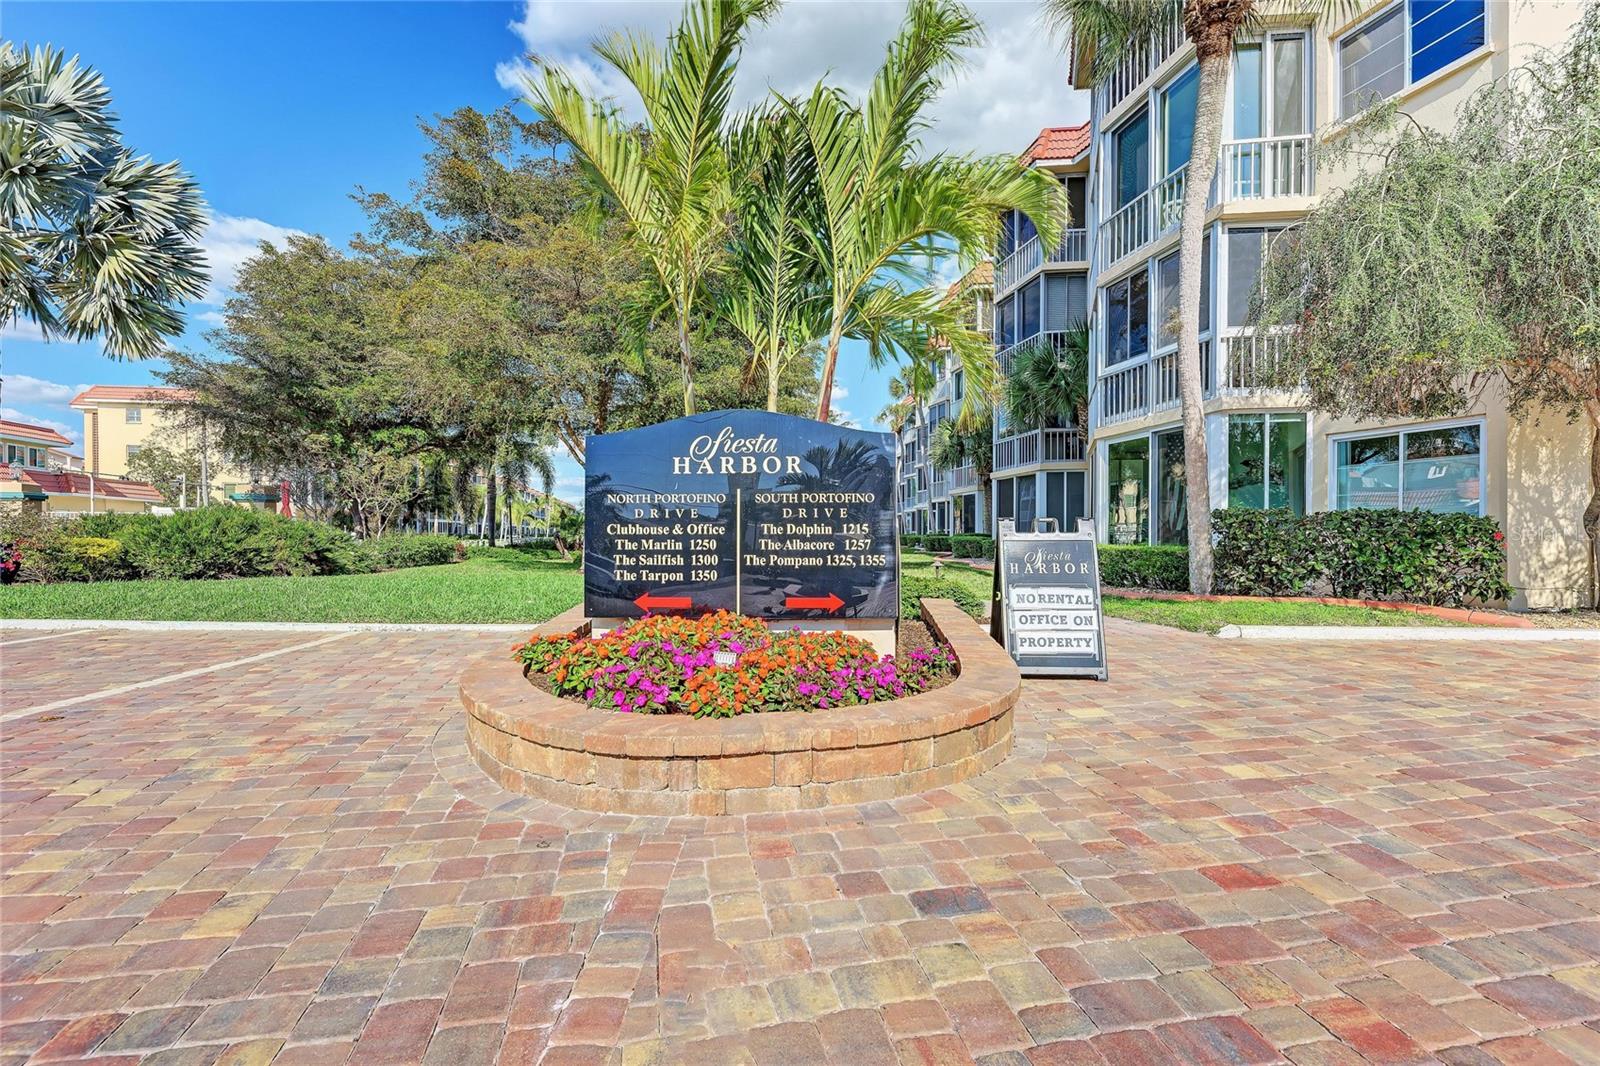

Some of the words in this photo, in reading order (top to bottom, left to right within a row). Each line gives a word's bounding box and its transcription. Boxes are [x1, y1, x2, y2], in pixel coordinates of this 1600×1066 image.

[690, 426, 778, 463] Siesta
[672, 456, 803, 475] HARBOR
[607, 493, 651, 504] NORTH
[654, 493, 726, 504] PORTOFINO
[754, 493, 799, 504] SOUTH
[801, 493, 875, 504] PORTOFINO
[634, 508, 699, 519] DRIVE
[782, 508, 848, 519] DRIVE
[606, 523, 670, 535] Clubhouse
[672, 523, 684, 535] &
[686, 523, 726, 535] Office
[760, 523, 784, 535] The
[786, 523, 833, 538] Dolphin
[842, 523, 869, 535] 1215
[614, 539, 638, 551] The
[640, 539, 683, 551] Marlin
[689, 539, 717, 551] 1250
[758, 539, 781, 551] The
[783, 539, 835, 551] Albacore
[844, 539, 872, 551] 1257
[613, 554, 637, 566] The
[638, 554, 684, 566] Sailfish
[690, 554, 719, 566] 1300
[743, 554, 767, 566] The
[769, 554, 823, 569] Pompano
[826, 554, 857, 569] 1325,
[860, 554, 886, 566] 1355
[1024, 547, 1071, 569] Siesta
[1009, 562, 1090, 575] HARBOR
[613, 569, 637, 581] The
[639, 569, 684, 584] Tarpon
[690, 569, 718, 581] 1350
[1016, 593, 1036, 604] NO
[1037, 594, 1093, 605] RENTAL
[1018, 614, 1068, 626] OFFICE
[1073, 615, 1094, 626] ON
[1018, 637, 1093, 648] PROPERTY
